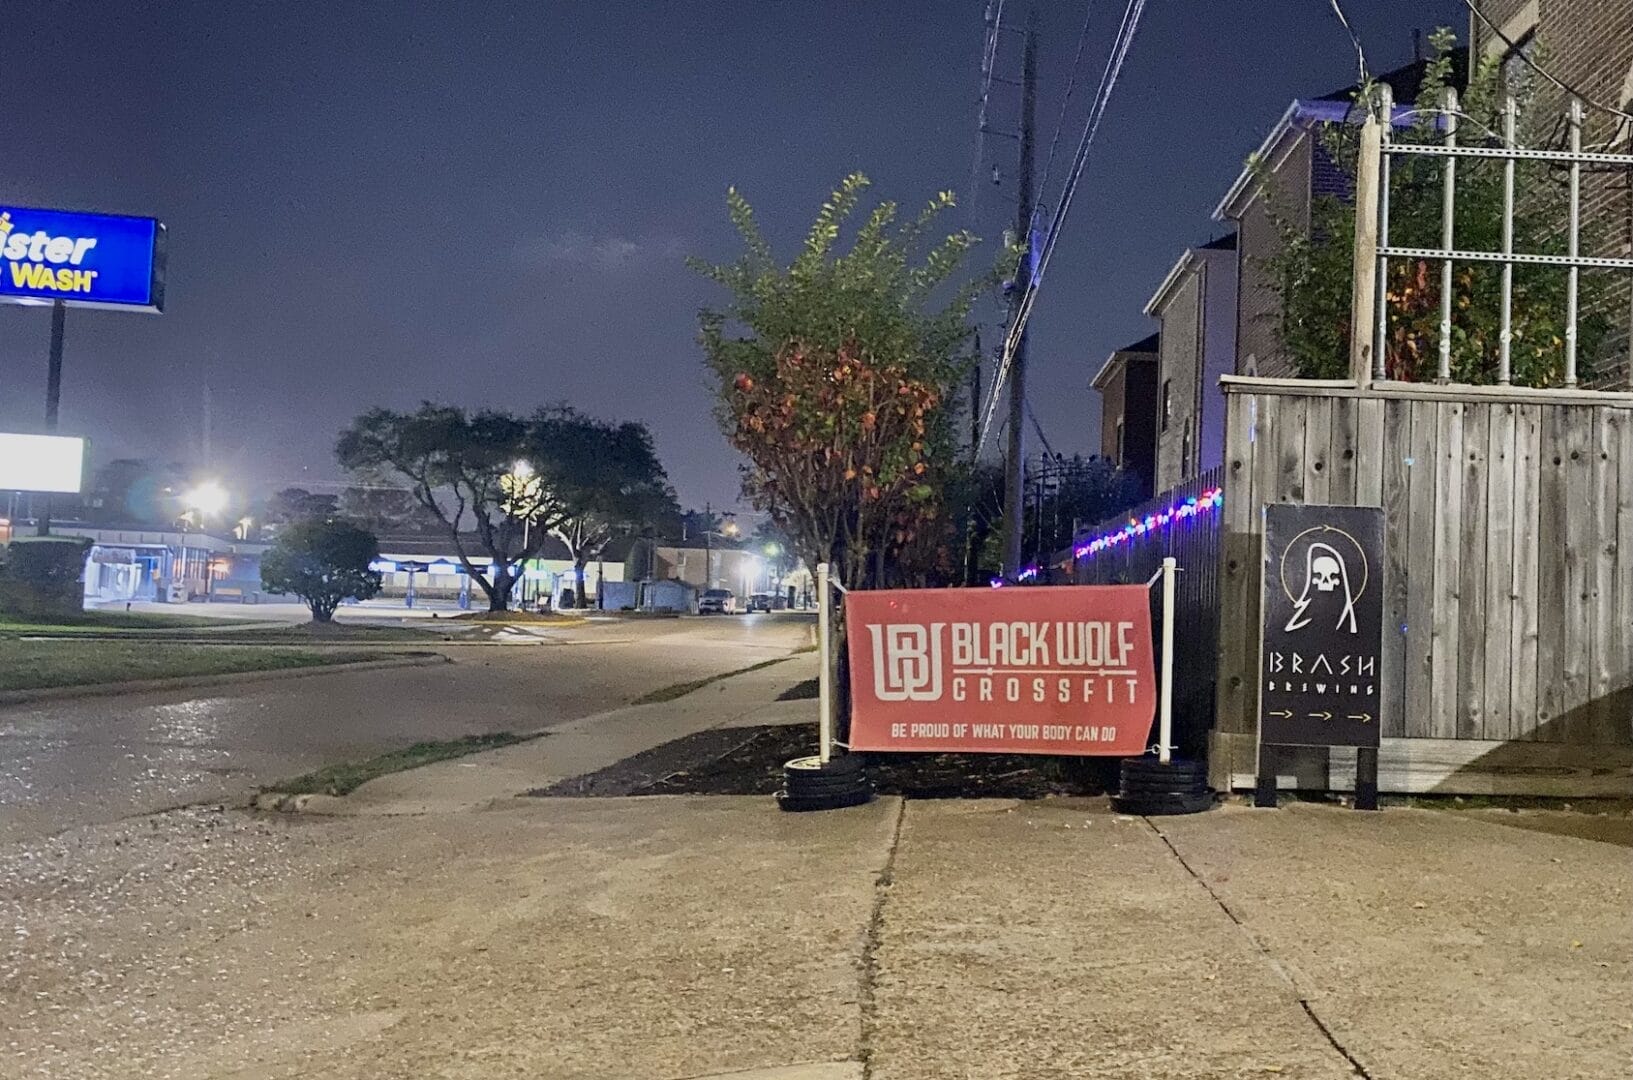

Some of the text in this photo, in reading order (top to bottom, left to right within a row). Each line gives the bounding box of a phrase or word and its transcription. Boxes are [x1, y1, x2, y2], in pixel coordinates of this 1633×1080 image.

[10, 261, 92, 293] WASH
[952, 621, 1134, 666] BLACK WOLF
[1269, 651, 1375, 677] BRASH
[952, 677, 1137, 703] CROSSFIT
[1268, 680, 1374, 696] BREWING
[891, 723, 1116, 742] BE PROUD OF WHAT YOUR BODY CAN DO
